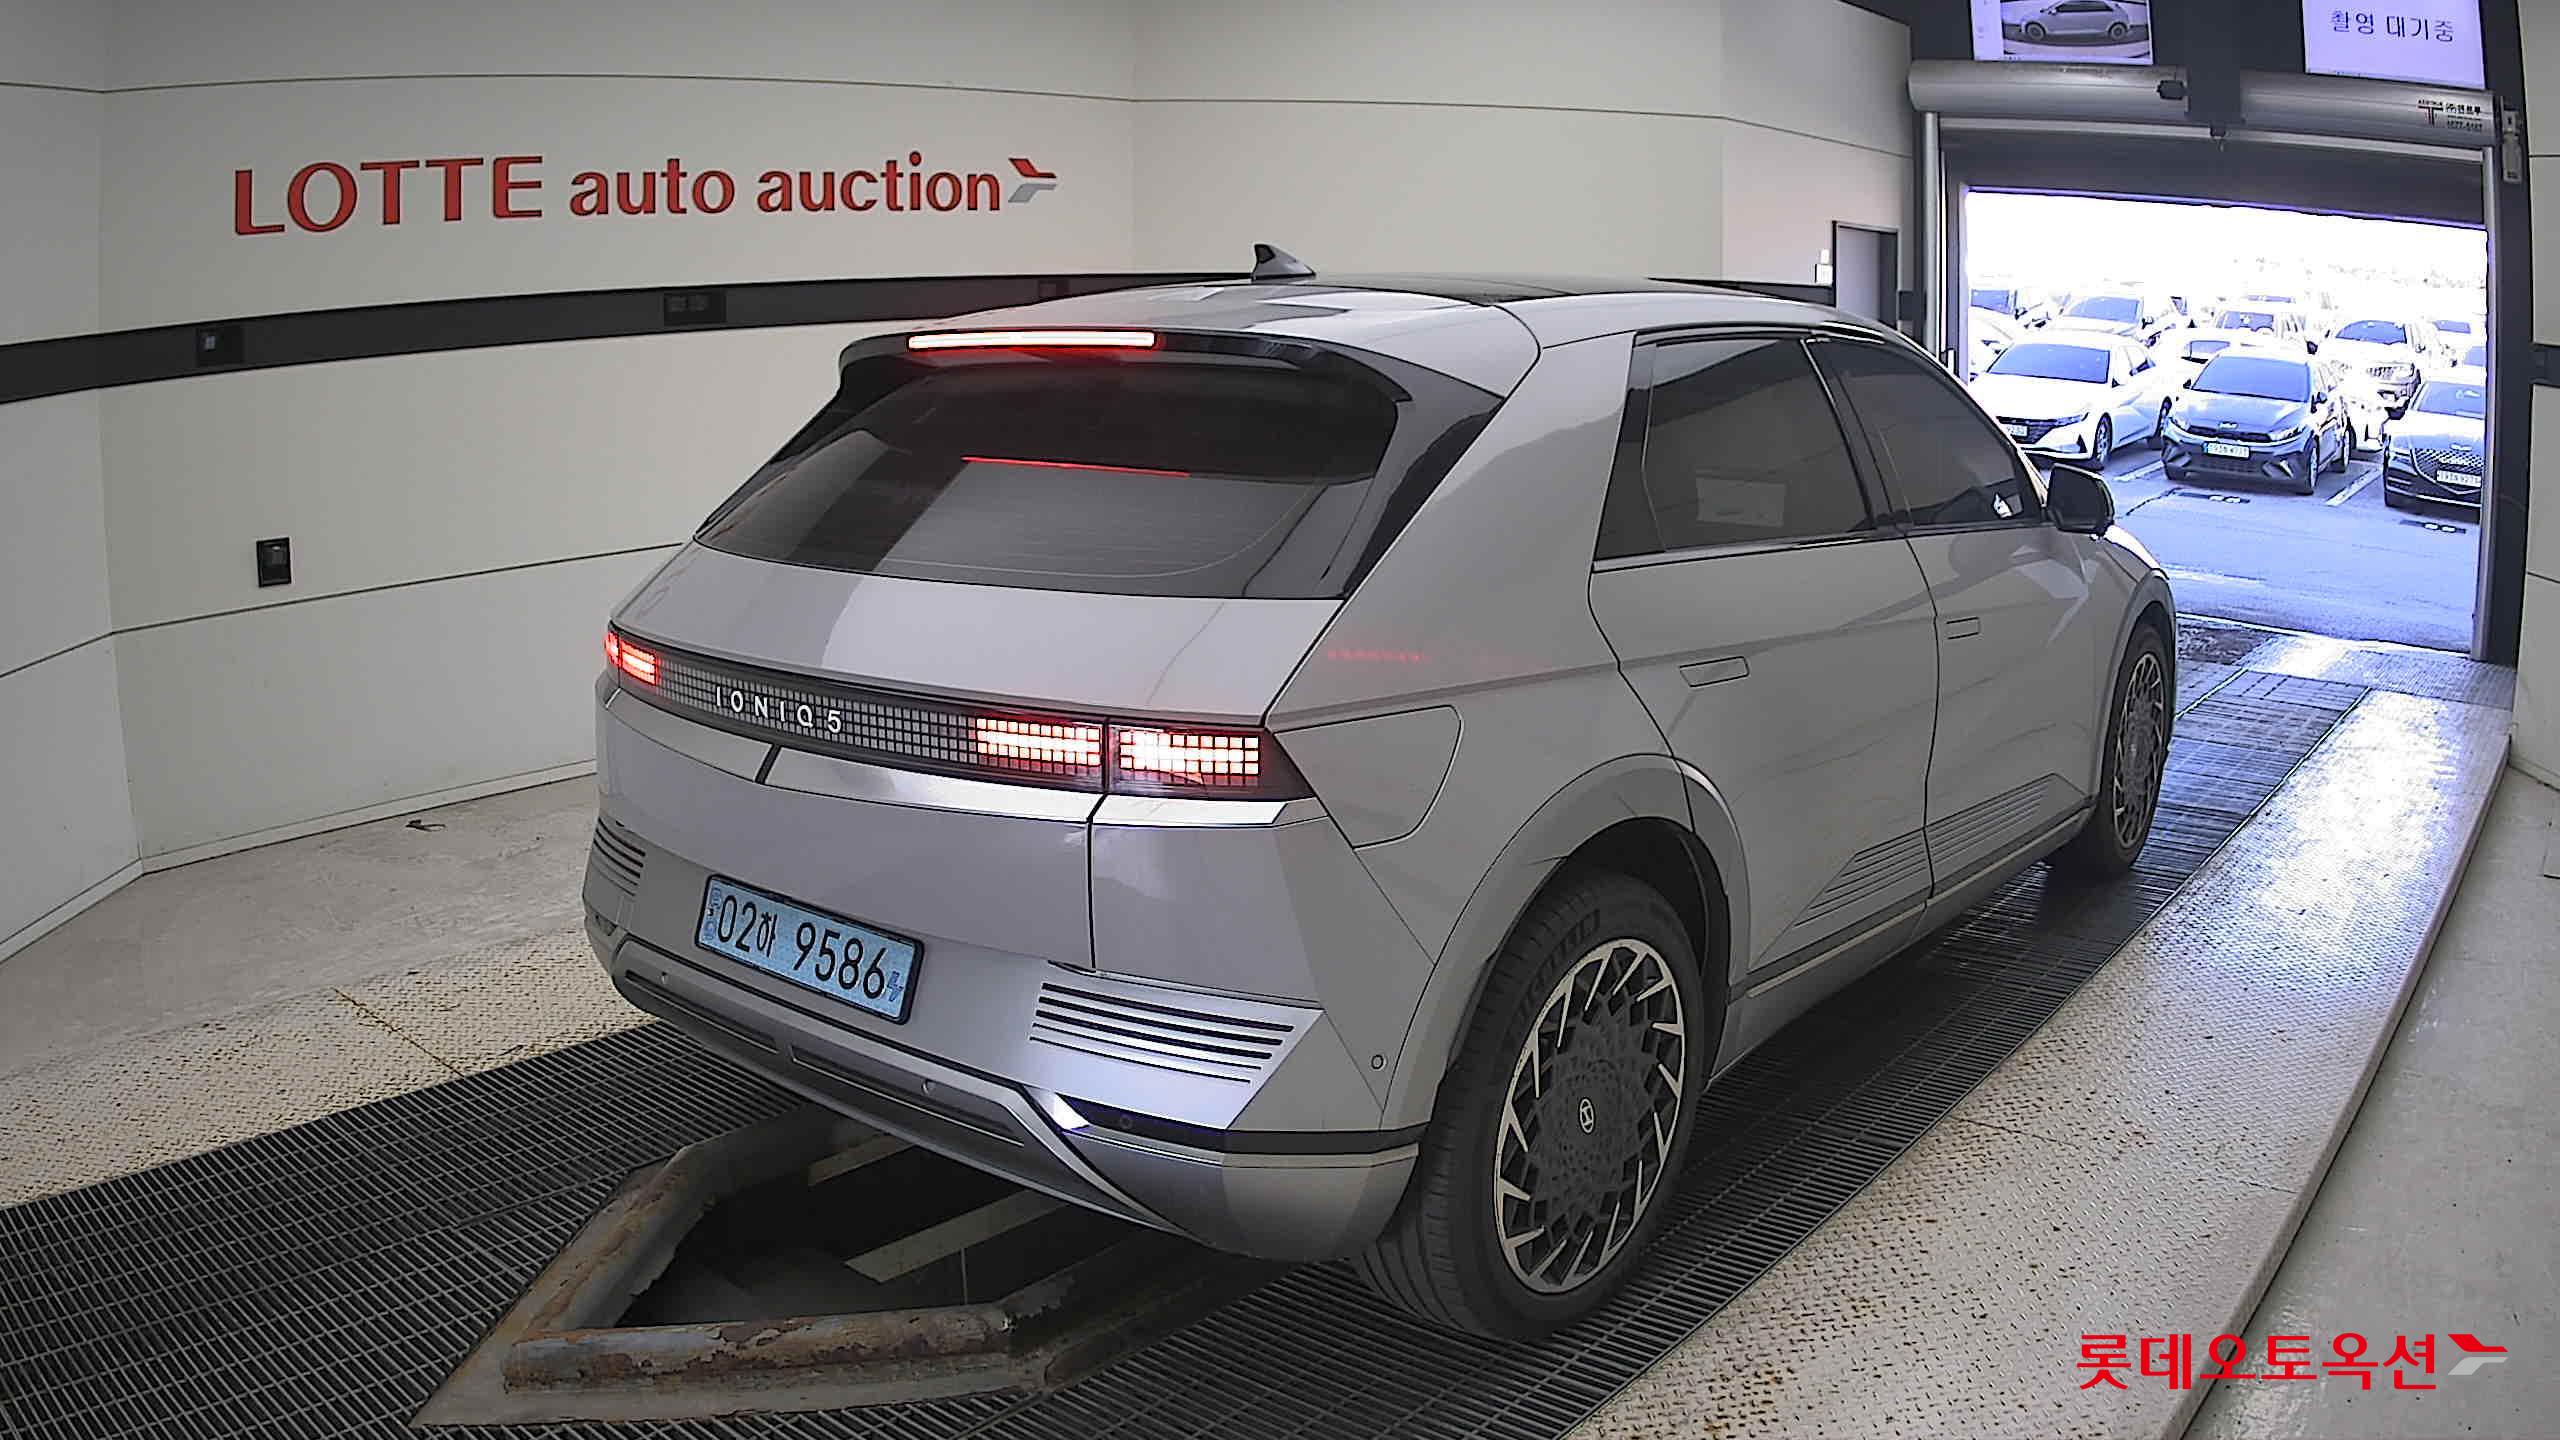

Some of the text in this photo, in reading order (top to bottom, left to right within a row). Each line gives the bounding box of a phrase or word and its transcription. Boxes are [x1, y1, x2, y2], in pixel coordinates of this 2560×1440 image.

[2331, 10, 2454, 42] 촬영 대기중
[236, 151, 1002, 235] LOTTE auto auction
[716, 686, 842, 733] IONIQ 5
[717, 895, 779, 958] 02하
[793, 922, 887, 999] 9586
